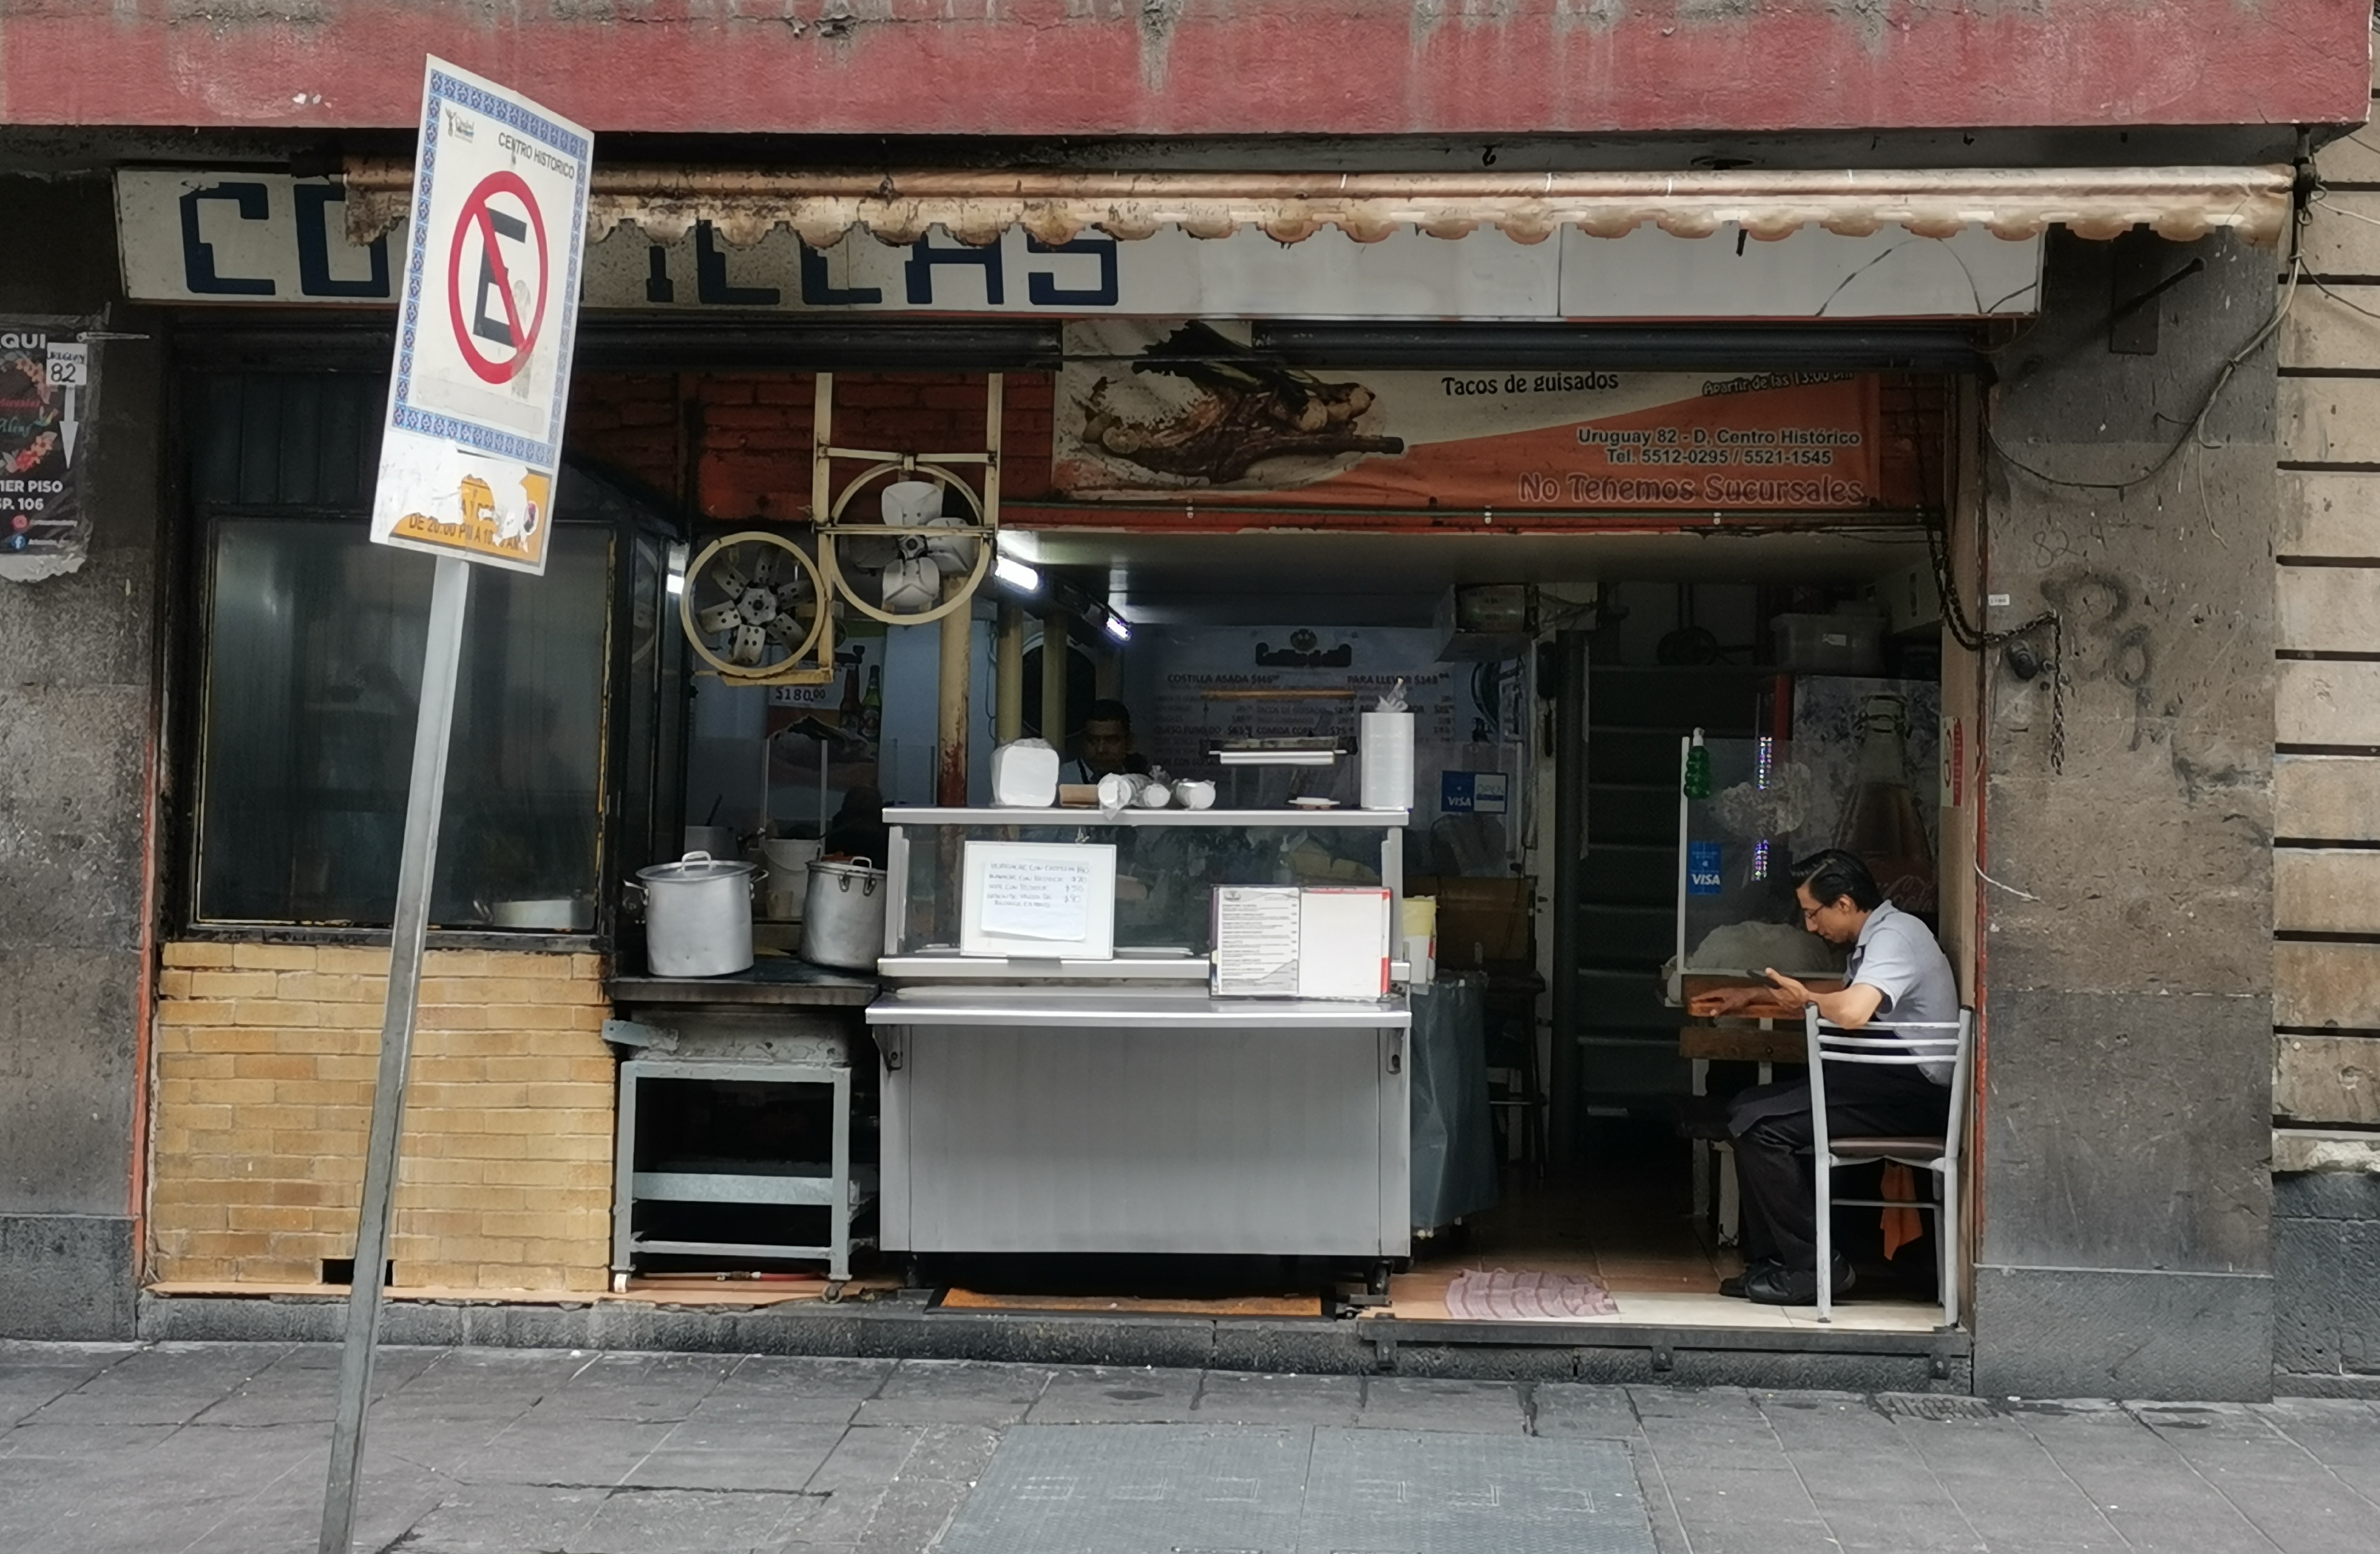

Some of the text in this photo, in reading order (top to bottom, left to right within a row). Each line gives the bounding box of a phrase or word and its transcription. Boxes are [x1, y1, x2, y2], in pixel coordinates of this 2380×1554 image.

[498, 132, 575, 179] CENTRO HISTORICO
[0, 333, 46, 349] QUI
[51, 362, 76, 384] 82
[1442, 372, 1619, 396] Tacos de guisados
[1752, 375, 1768, 390] de
[1577, 428, 1651, 446] Uruguay
[1655, 428, 1677, 445] 82
[1693, 428, 1713, 447] D,
[1716, 429, 1775, 445] Centro
[1780, 428, 1861, 446] Histórico
[1607, 448, 1636, 464] Tel.
[1640, 448, 1729, 466] 5512-0295
[1743, 448, 1832, 466] 5521-1545
[28, 480, 63, 493] PISO
[1518, 473, 1866, 506] No Tenemos Sucursales
[0, 497, 44, 511] P. 106
[409, 513, 425, 530] DE
[1168, 674, 1213, 684] COSTILLA
[1215, 674, 1249, 683] ASADA
[1347, 675, 1374, 684] PARA
[1447, 796, 1471, 807] VISA
[1690, 874, 1721, 885] VISA
